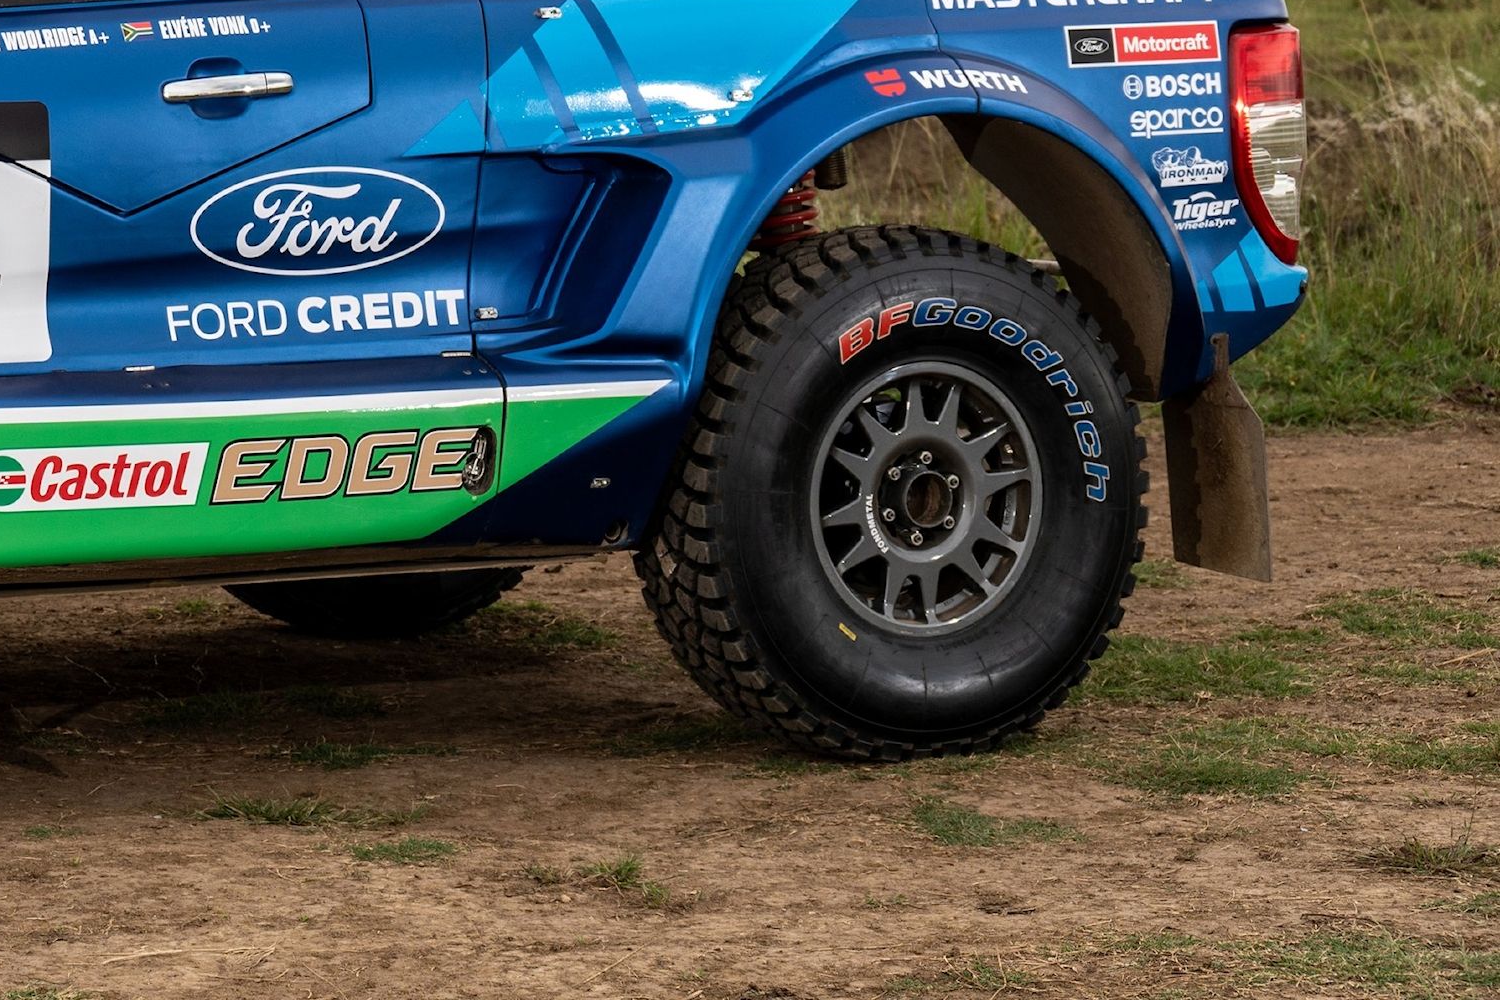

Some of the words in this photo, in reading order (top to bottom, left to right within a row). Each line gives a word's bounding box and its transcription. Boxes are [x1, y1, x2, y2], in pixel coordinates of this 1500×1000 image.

[1, 26, 88, 51] WOOLRIDGE
[88, 29, 110, 45] A+
[158, 15, 208, 40] ELVÉNE
[207, 15, 249, 36] VONK
[1080, 39, 1104, 52] Ford
[1123, 33, 1209, 53] Motorcraft
[1145, 72, 1222, 98] BOSCH
[1130, 106, 1224, 139] sparco
[1164, 166, 1223, 179] IRONMAN
[236, 182, 402, 259] Ford
[1173, 191, 1240, 224] Tiger
[1174, 218, 1237, 231] Wheel&Tyre
[166, 299, 288, 342] FORD
[297, 289, 465, 334] CREDIT
[839, 297, 1111, 502] BFGoodrich
[30, 450, 191, 503] Castrol
[209, 427, 482, 506] EDGE
[865, 493, 890, 554] FONDMETAL
